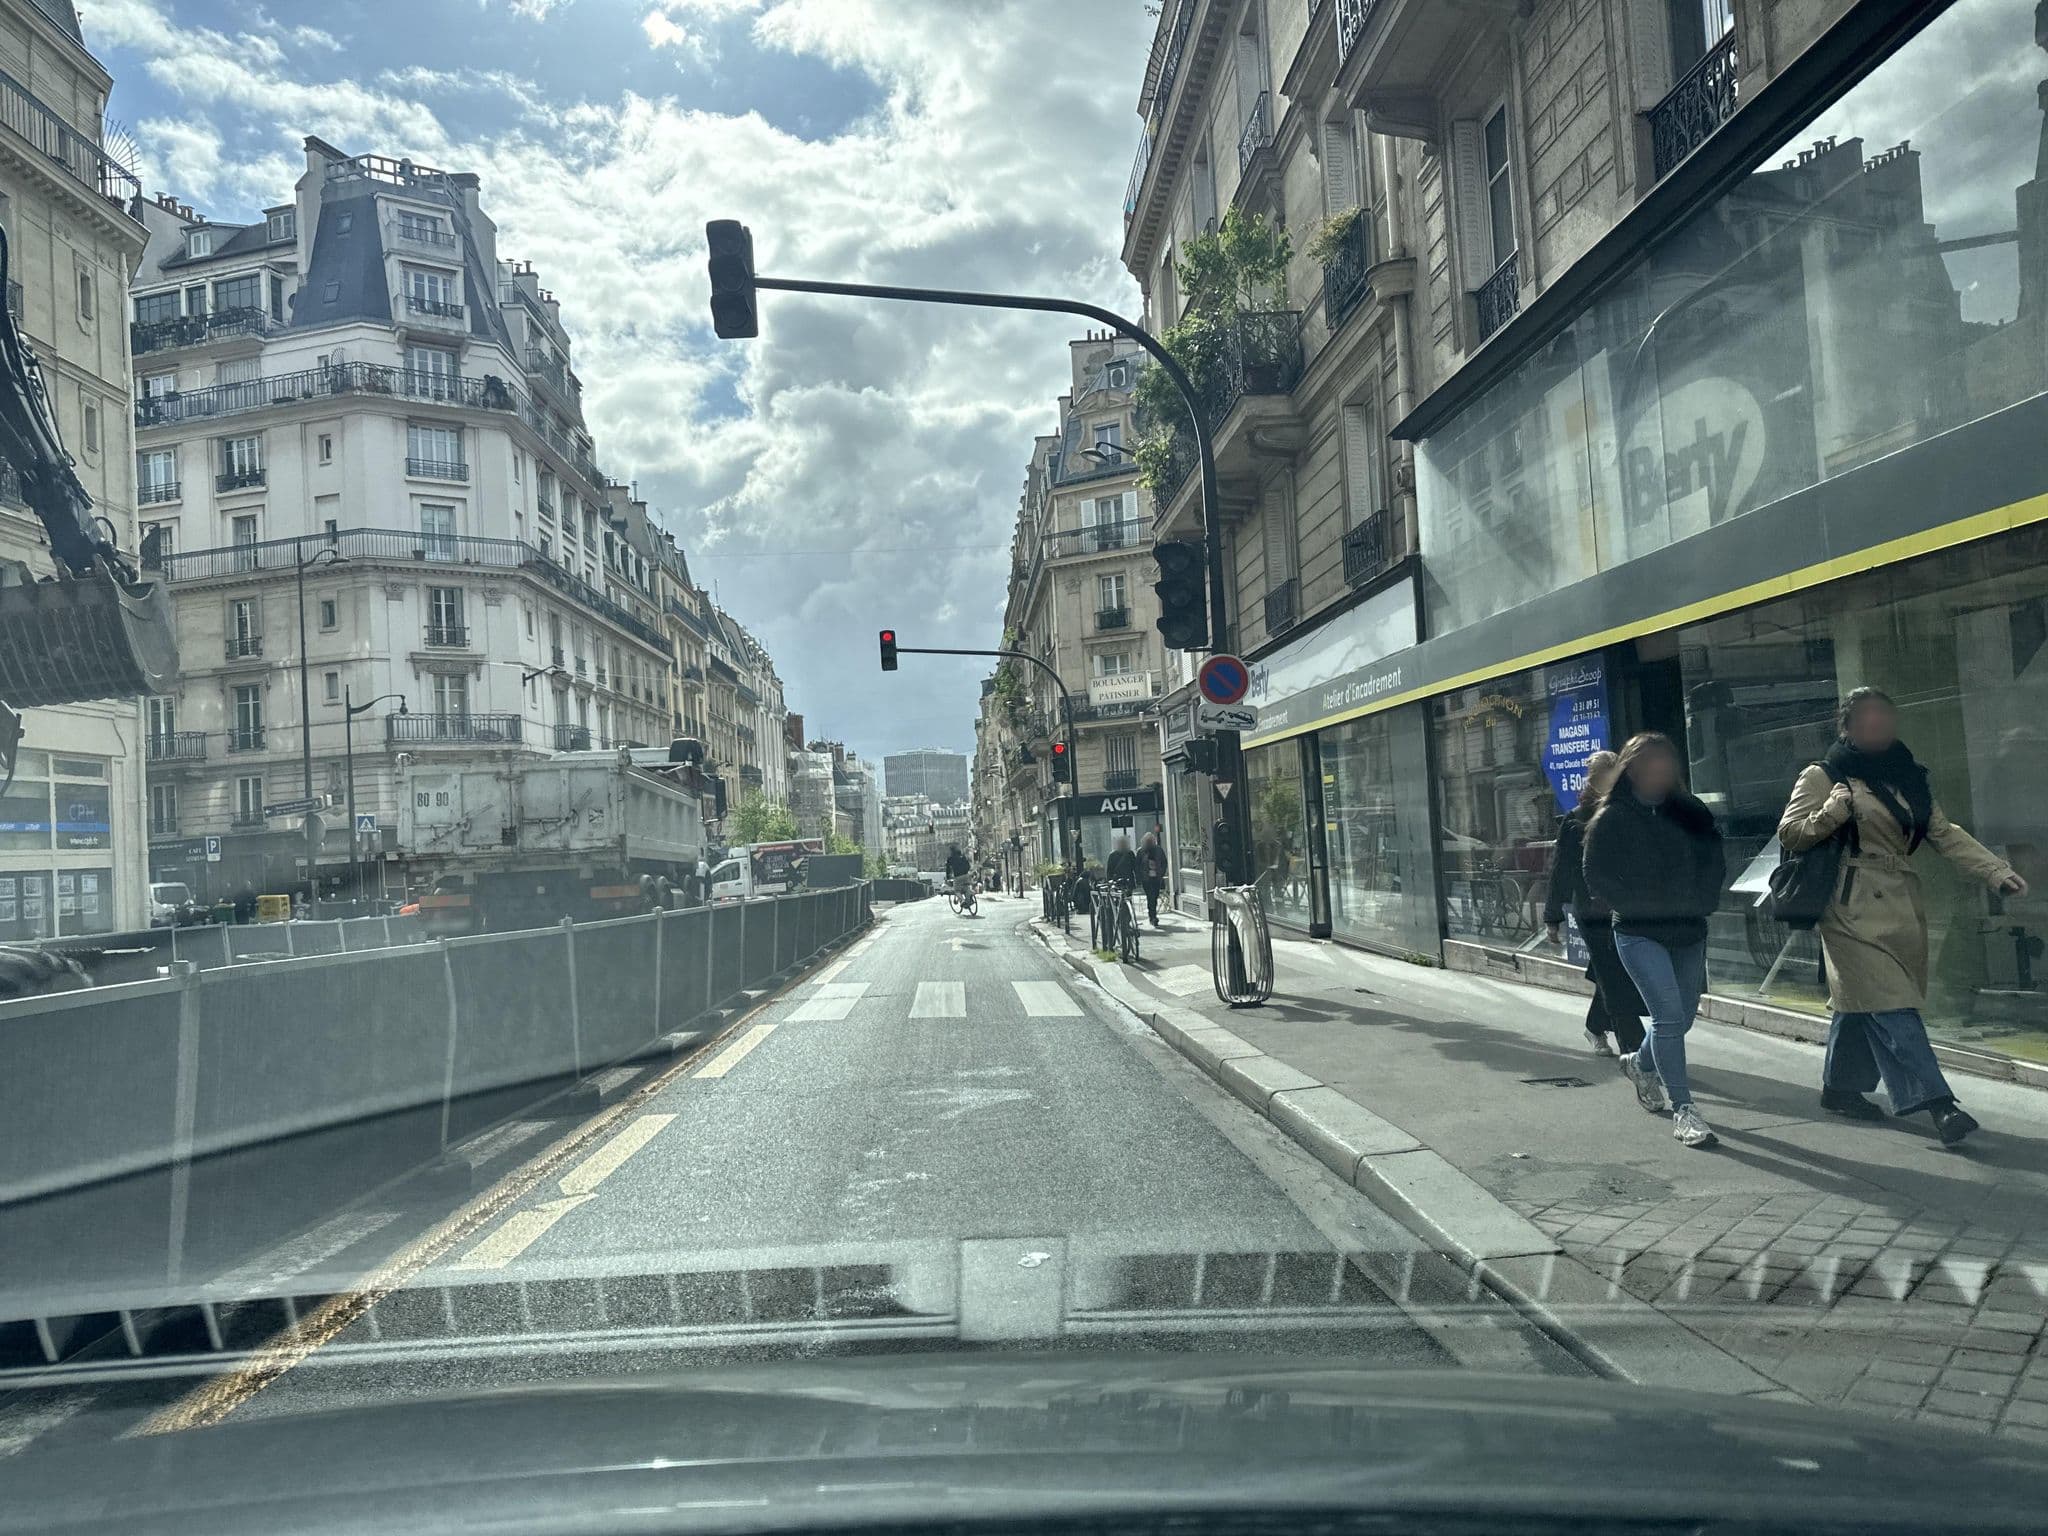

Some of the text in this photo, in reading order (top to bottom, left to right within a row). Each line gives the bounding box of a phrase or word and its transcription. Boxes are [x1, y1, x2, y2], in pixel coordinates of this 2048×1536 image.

[1092, 674, 1145, 688] BOULANGER
[1322, 667, 1402, 711] Atelier d'Encadrement
[1558, 724, 1590, 739] MAGASIN
[1551, 738, 1601, 756] TRANSFERE AU
[1561, 774, 1568, 791] à
[417, 791, 449, 808] 80 90
[1100, 796, 1138, 813] AGL
[210, 840, 217, 852] P
